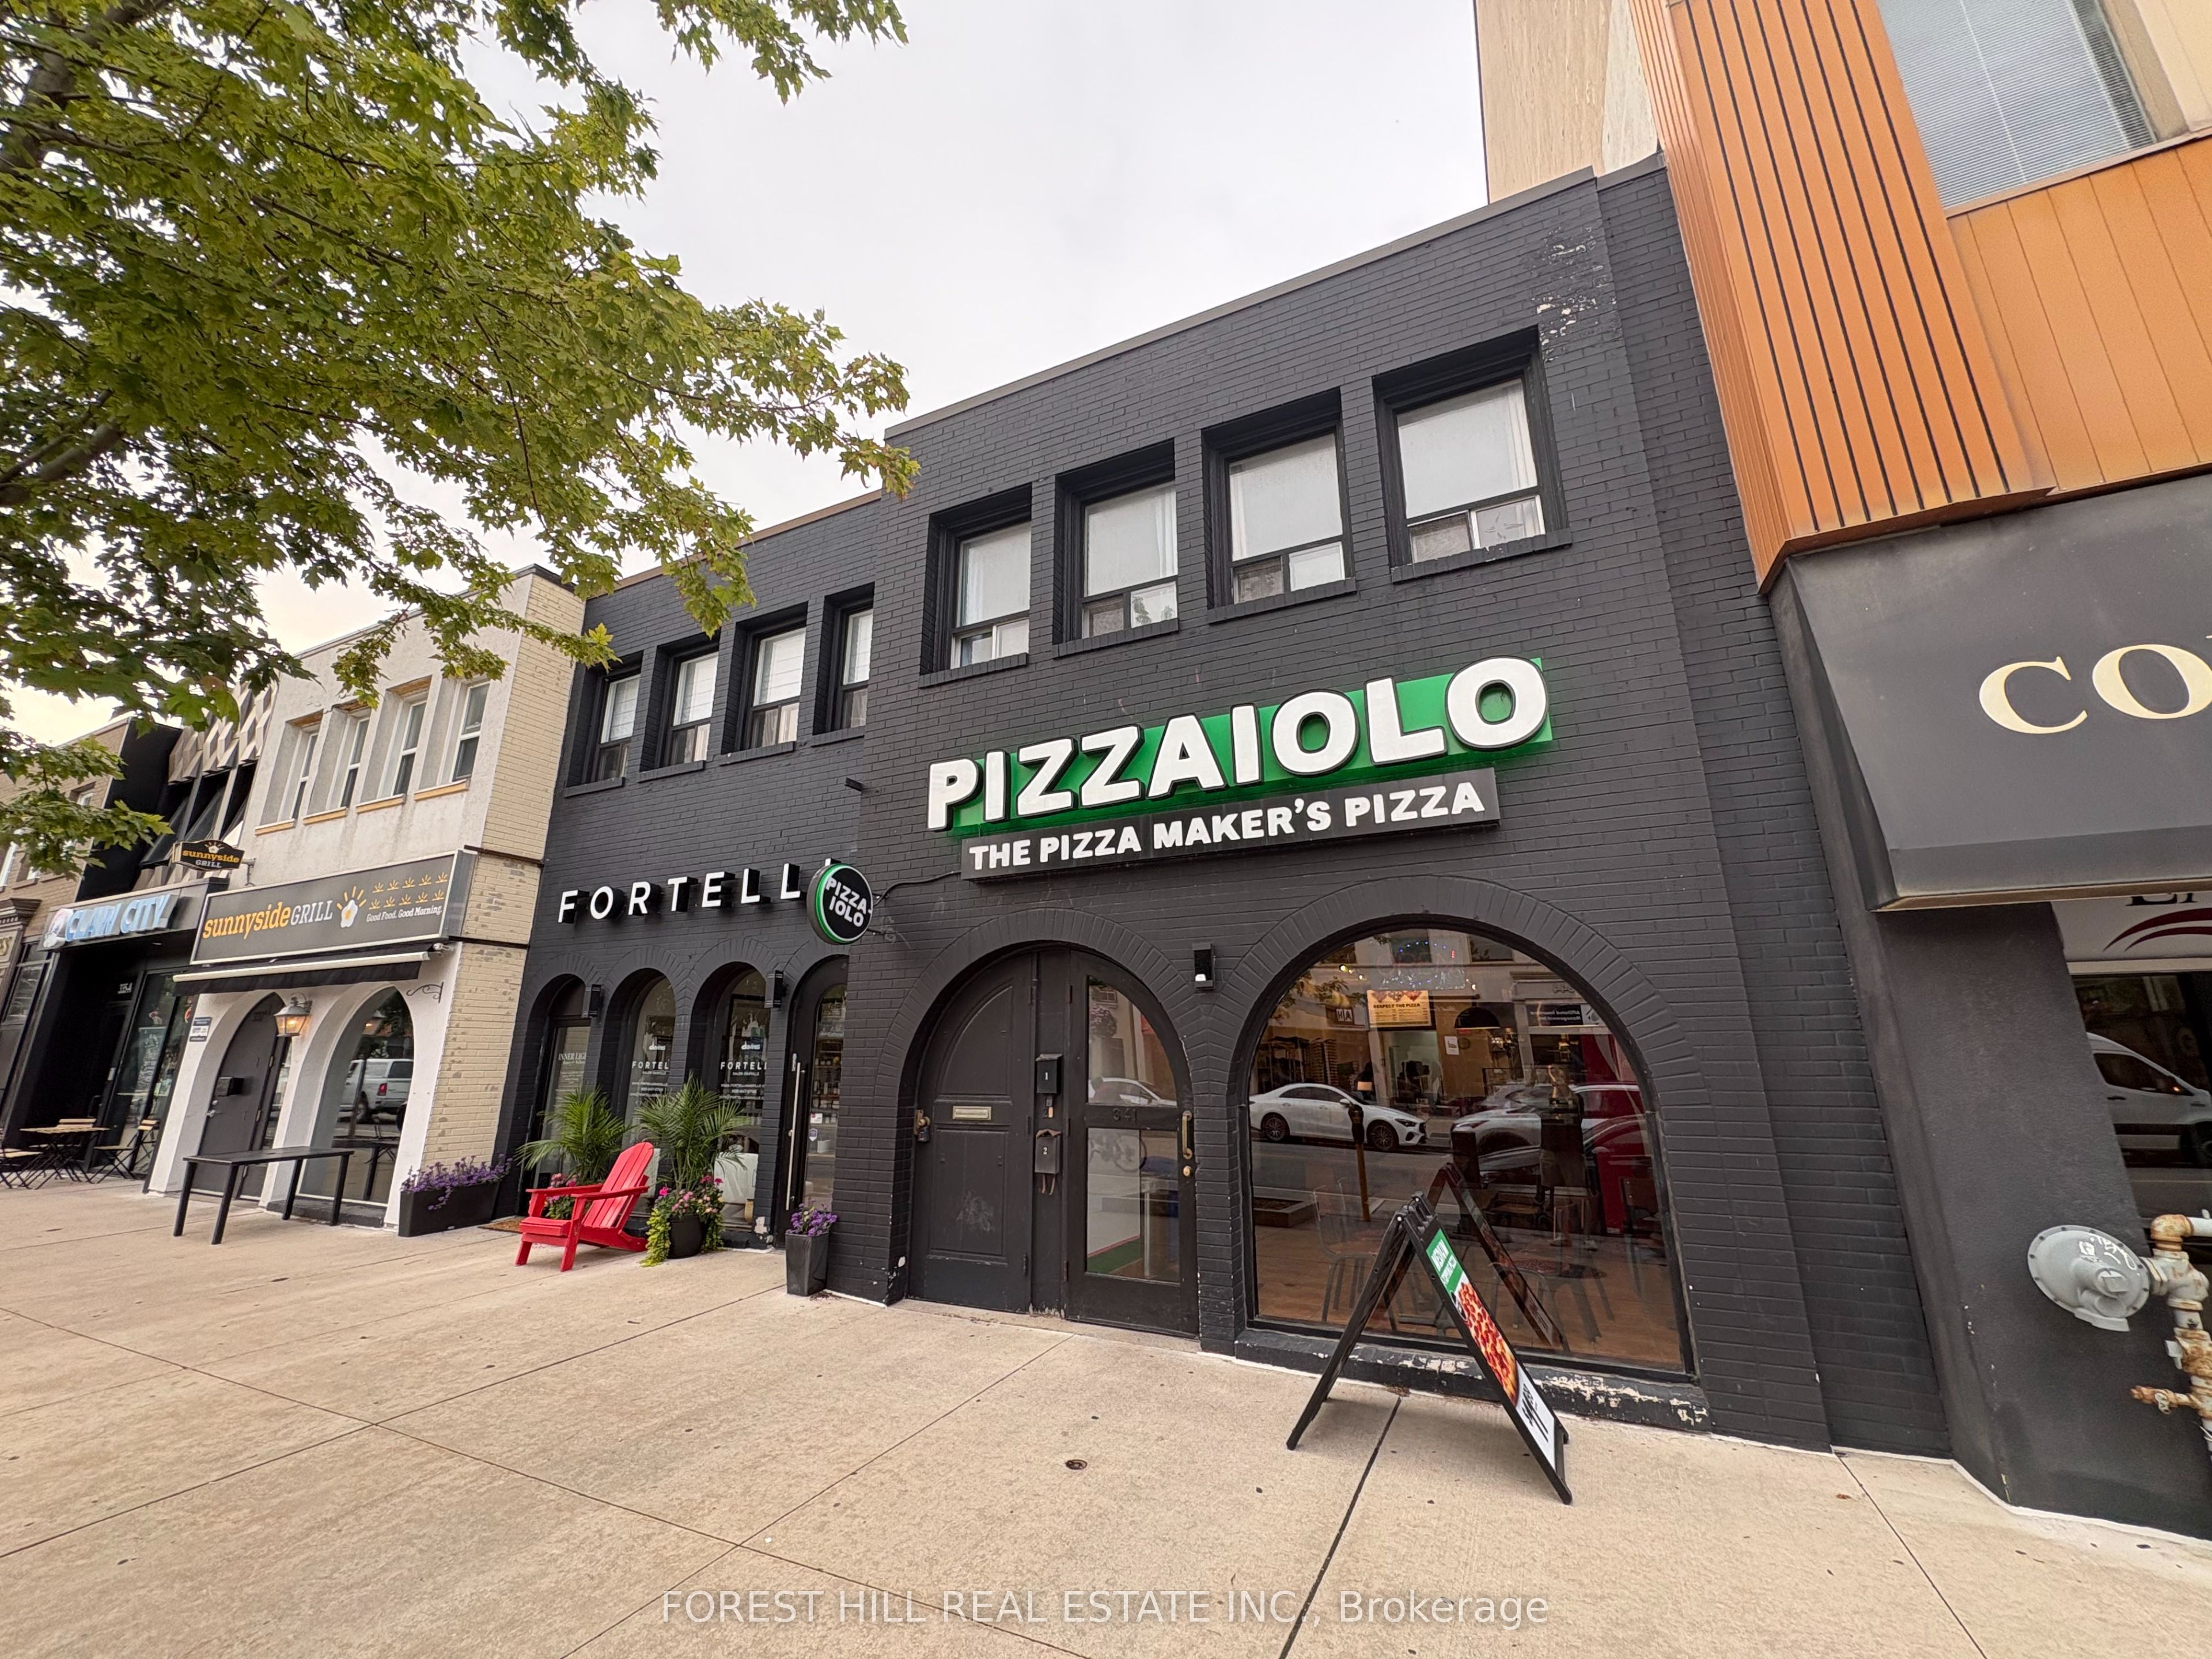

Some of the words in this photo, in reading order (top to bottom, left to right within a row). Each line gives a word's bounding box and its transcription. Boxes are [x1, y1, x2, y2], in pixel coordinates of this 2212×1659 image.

[1979, 634, 2212, 734] CO
[927, 657, 1547, 831] PIZZAIOLO
[969, 839, 1031, 870] THE
[1040, 826, 1142, 863] PIZZA
[1344, 782, 1485, 827] PIZZA
[182, 849, 240, 863] sunnyside
[195, 859, 222, 868] GRILL
[65, 903, 122, 942] CLAW
[120, 894, 174, 934] CITY
[202, 902, 291, 940] sunnyside
[290, 900, 333, 926] GRILL
[366, 913, 381, 922] Good
[381, 911, 397, 921] Food.
[398, 909, 414, 919] Good
[829, 895, 864, 927] IOLO
[1044, 1072, 1049, 1081] 1
[1043, 1146, 1048, 1155] 2
